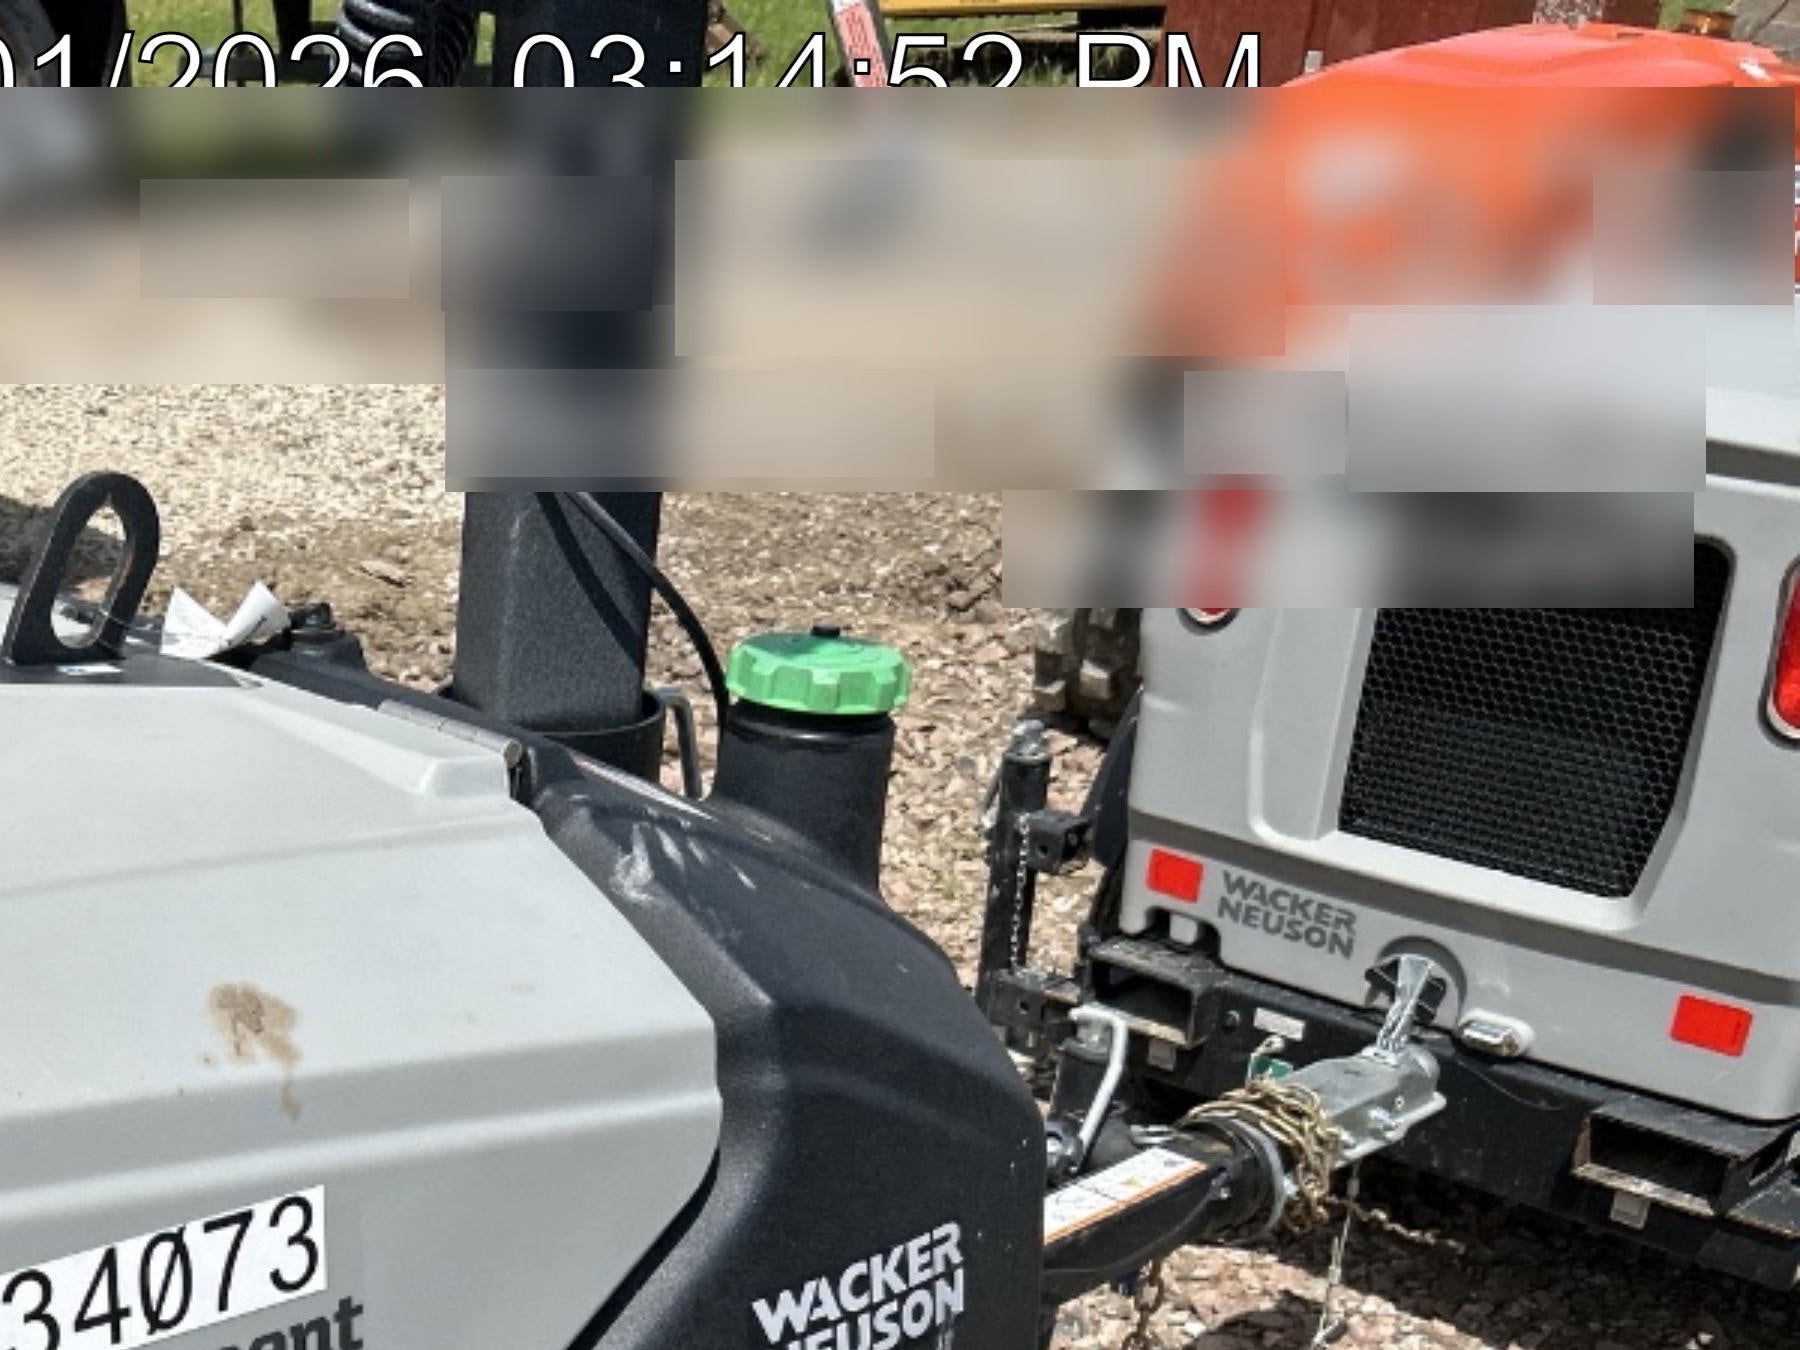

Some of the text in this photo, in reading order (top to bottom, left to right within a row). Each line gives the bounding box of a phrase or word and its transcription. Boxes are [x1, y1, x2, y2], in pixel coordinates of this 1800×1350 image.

[1217, 896, 1356, 960] NEUSON
[1222, 870, 1357, 937] WACKER
[751, 1220, 964, 1345] WACKER
